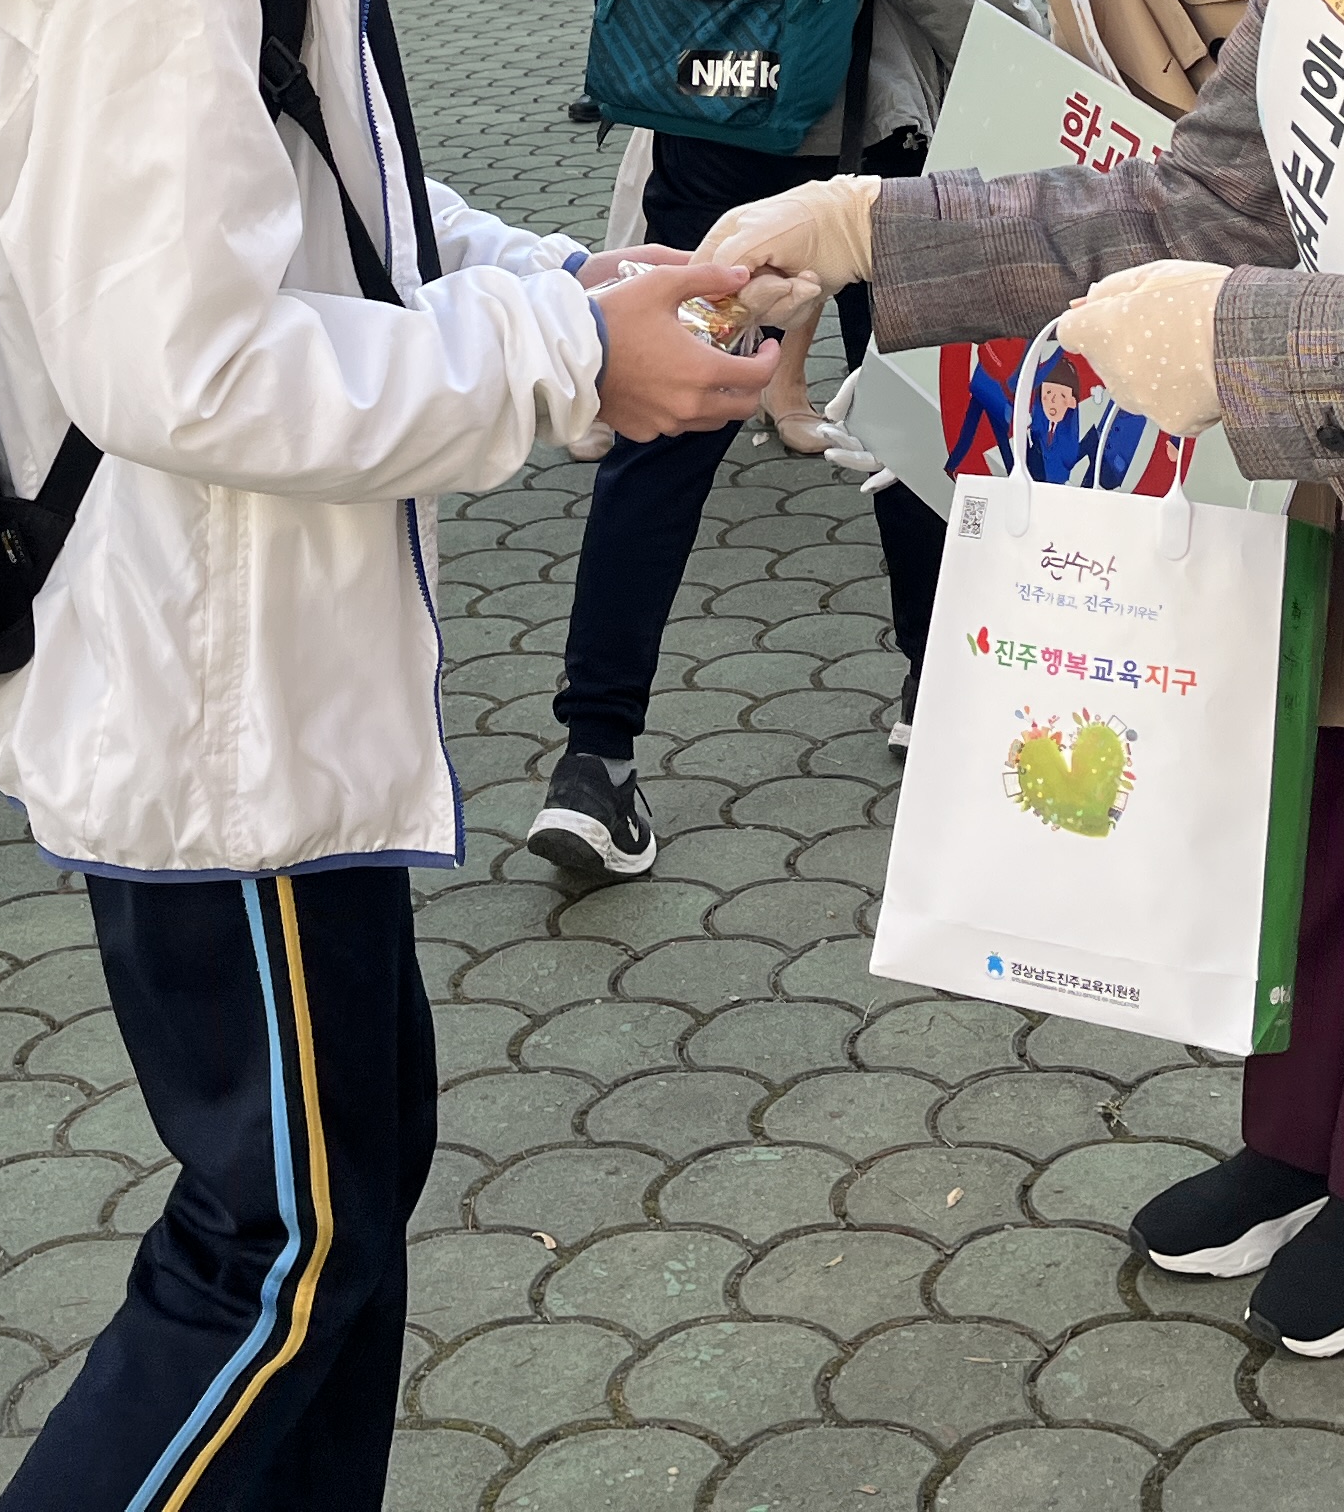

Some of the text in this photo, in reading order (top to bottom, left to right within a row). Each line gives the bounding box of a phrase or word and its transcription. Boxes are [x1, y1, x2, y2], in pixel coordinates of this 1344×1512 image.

[692, 59, 755, 87] NIKE
[1059, 91, 1163, 174] 학교
[1041, 541, 1117, 591] 현수막
[1010, 961, 1141, 1002] 경상남도진주교육지원청
